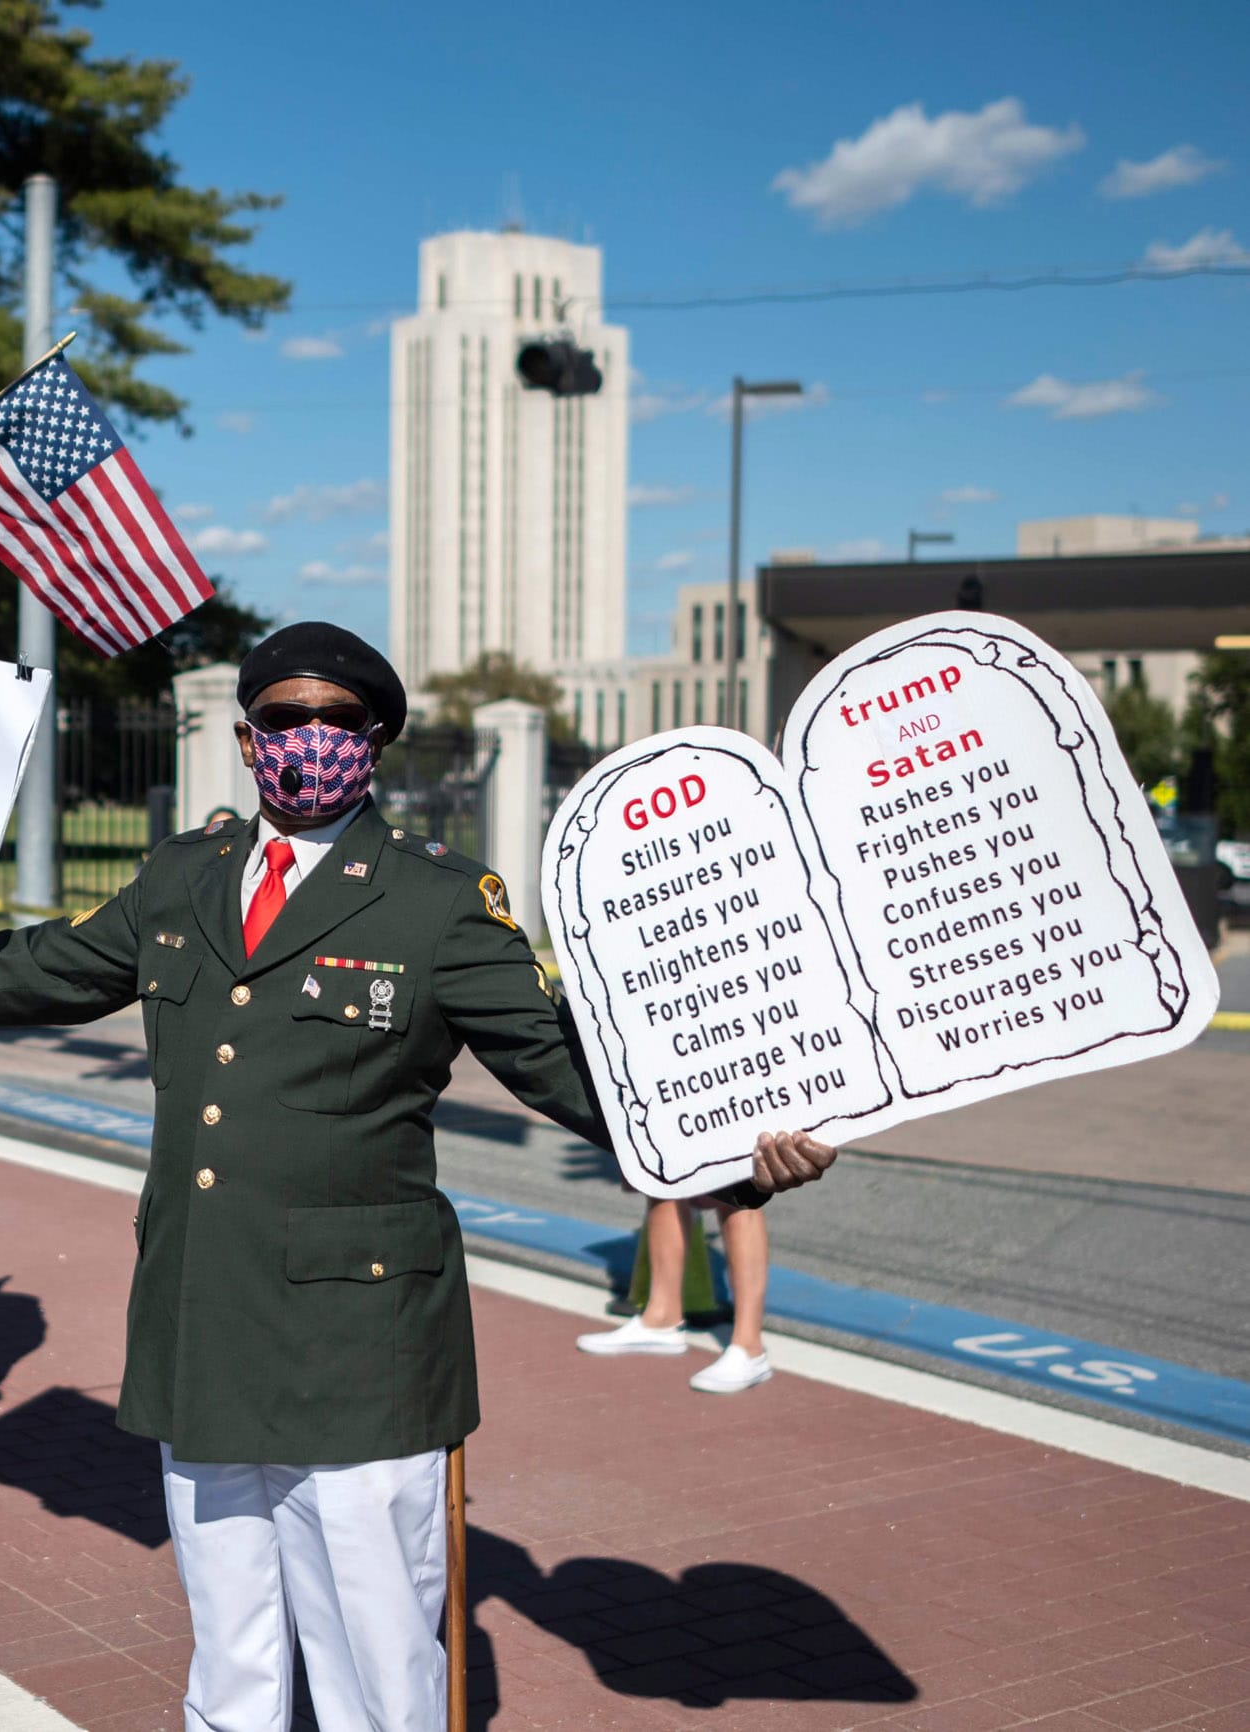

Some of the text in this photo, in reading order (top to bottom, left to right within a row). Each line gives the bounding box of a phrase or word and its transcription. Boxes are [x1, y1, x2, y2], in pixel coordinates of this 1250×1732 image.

[841, 666, 961, 726] trump
[900, 715, 940, 741] AND
[867, 730, 983, 787] Satan
[624, 775, 705, 830] GOD
[857, 786, 1038, 863] Frightens you
[861, 760, 1009, 826] Rushes you
[622, 818, 731, 875] Stills you
[884, 824, 1034, 889] Pushes you
[603, 842, 775, 922] Reassures you
[884, 852, 1060, 924] Confuses you
[639, 889, 759, 948] Leads you
[888, 882, 1081, 959] Condemns you
[622, 914, 802, 994] Enlightens you
[897, 944, 1122, 1028] Discourages you
[910, 919, 1082, 988] Stresses you
[645, 956, 802, 1026] Forgives you
[937, 988, 1103, 1051] Worries you
[673, 1000, 798, 1056] Calms you
[657, 1027, 842, 1103] Encourage You
[678, 1069, 845, 1137] Comforts you
[952, 1332, 1158, 1396] U.S.
